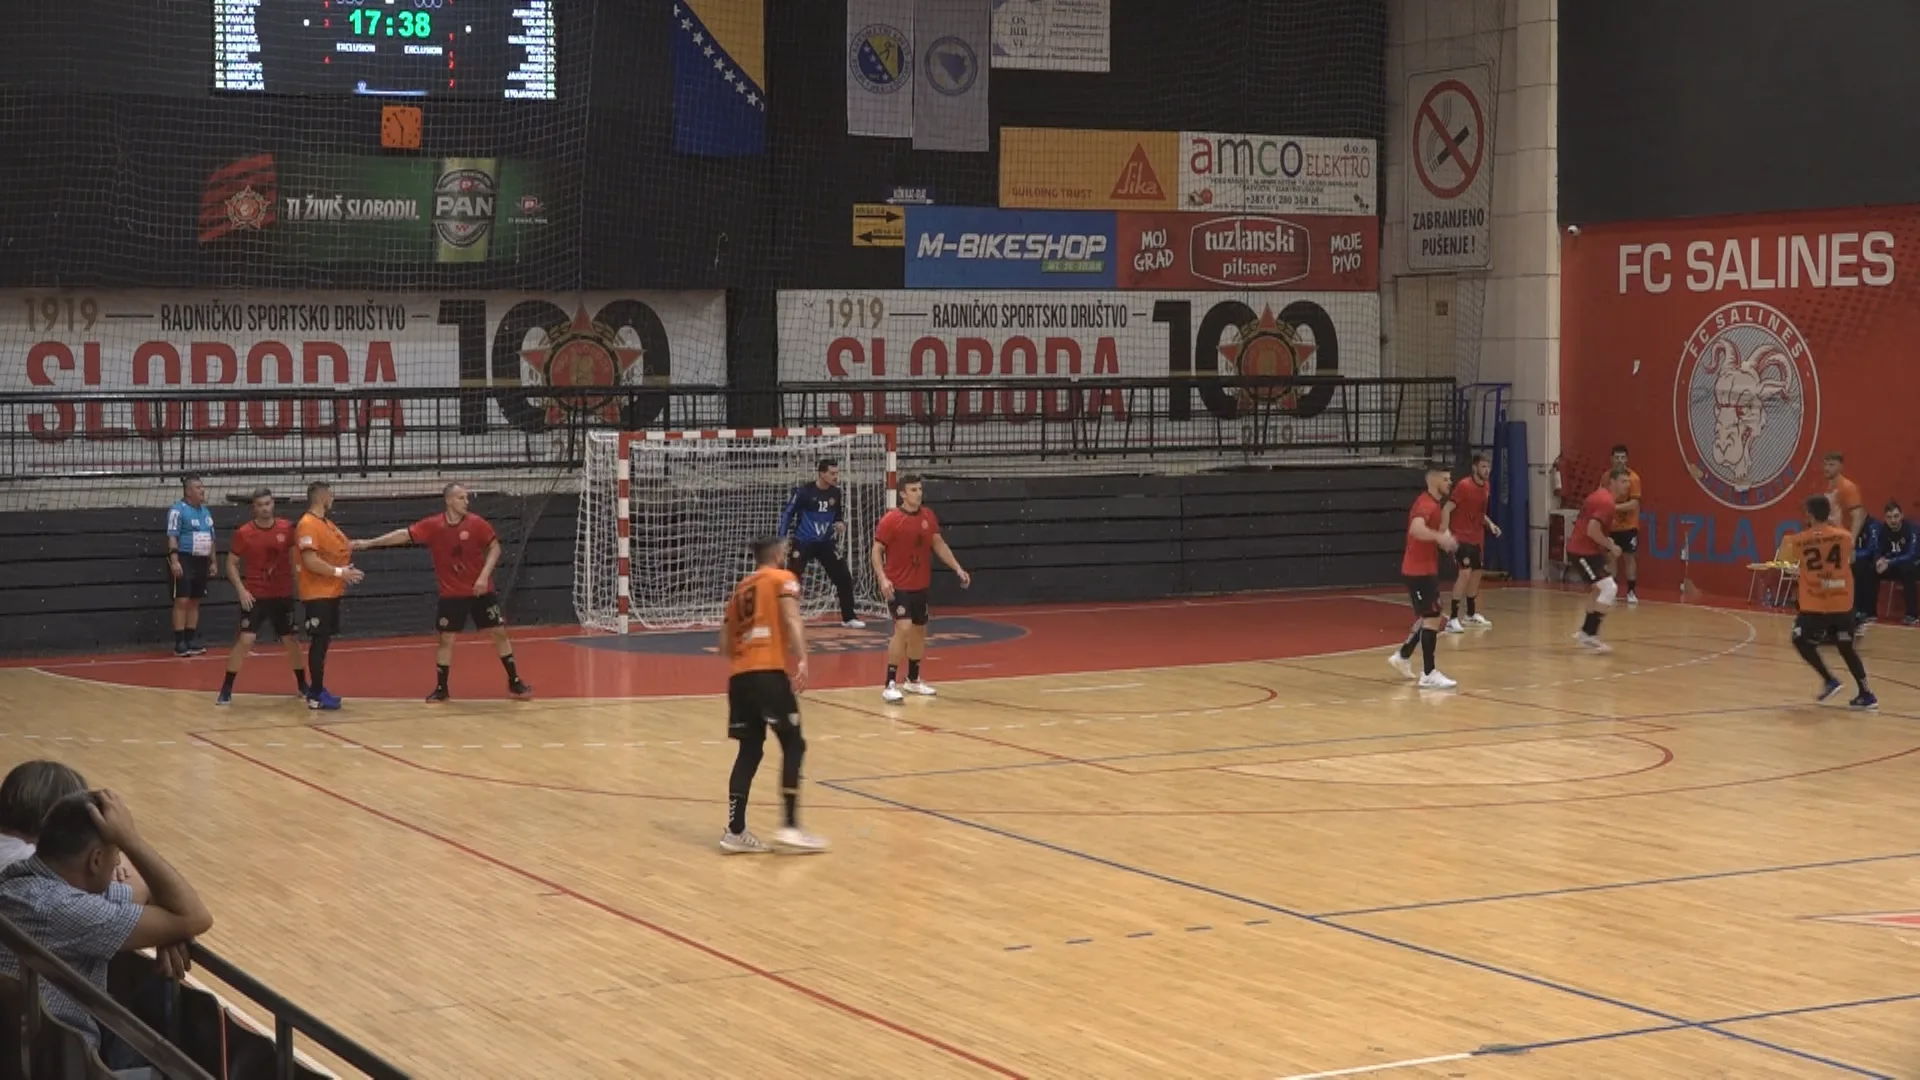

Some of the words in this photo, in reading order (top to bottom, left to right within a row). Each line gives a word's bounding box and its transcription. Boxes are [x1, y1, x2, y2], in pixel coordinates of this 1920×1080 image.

[350, 9, 431, 37] 17:38
[336, 43, 376, 52] EXCLUSION
[404, 45, 443, 55] EXCLUSION
[1190, 138, 1304, 178] amco
[1306, 153, 1371, 178] ELEKTRO
[1118, 162, 1158, 194] Sika
[287, 198, 300, 220] TI
[303, 193, 343, 220] ŽIVIŠ
[345, 198, 420, 221] SLOBODU.
[436, 196, 493, 216] PAN
[1012, 187, 1058, 198] BUILDING
[1061, 188, 1093, 199] TRUST
[1412, 208, 1485, 230] ZABRANJENO
[917, 233, 1107, 260] M-BIKESHOP
[1141, 229, 1167, 250] MOJ
[1205, 221, 1295, 253] tuzlanski
[1331, 231, 1362, 253] MOJE
[1134, 249, 1174, 271] GRAD
[1223, 257, 1277, 279] pilsner
[1333, 253, 1362, 274] PIVO
[1619, 243, 1672, 294] FC
[1687, 231, 1895, 291] SALINES
[24, 297, 98, 332] 1919
[161, 299, 243, 330] RADNIČKO
[248, 304, 329, 331] SPORTSKO
[335, 299, 406, 330] DRUŠTVO
[826, 297, 885, 329] 1919
[933, 299, 998, 328] RADNIČKO
[1001, 303, 1067, 328] SPORTSKO
[1071, 299, 1127, 328] DRUŠTVO
[1688, 328, 1710, 359] FC
[1715, 306, 1804, 359] SALINES
[437, 299, 671, 435] 100
[1152, 300, 1339, 421] 100
[27, 340, 406, 441] SLOBODA
[827, 335, 1126, 426] SLOBODA
[818, 501, 828, 512] 12
[813, 520, 830, 536] W
[1641, 512, 1759, 565] UZLA
[1803, 543, 1842, 571] 24
[1891, 540, 1902, 552] 16
